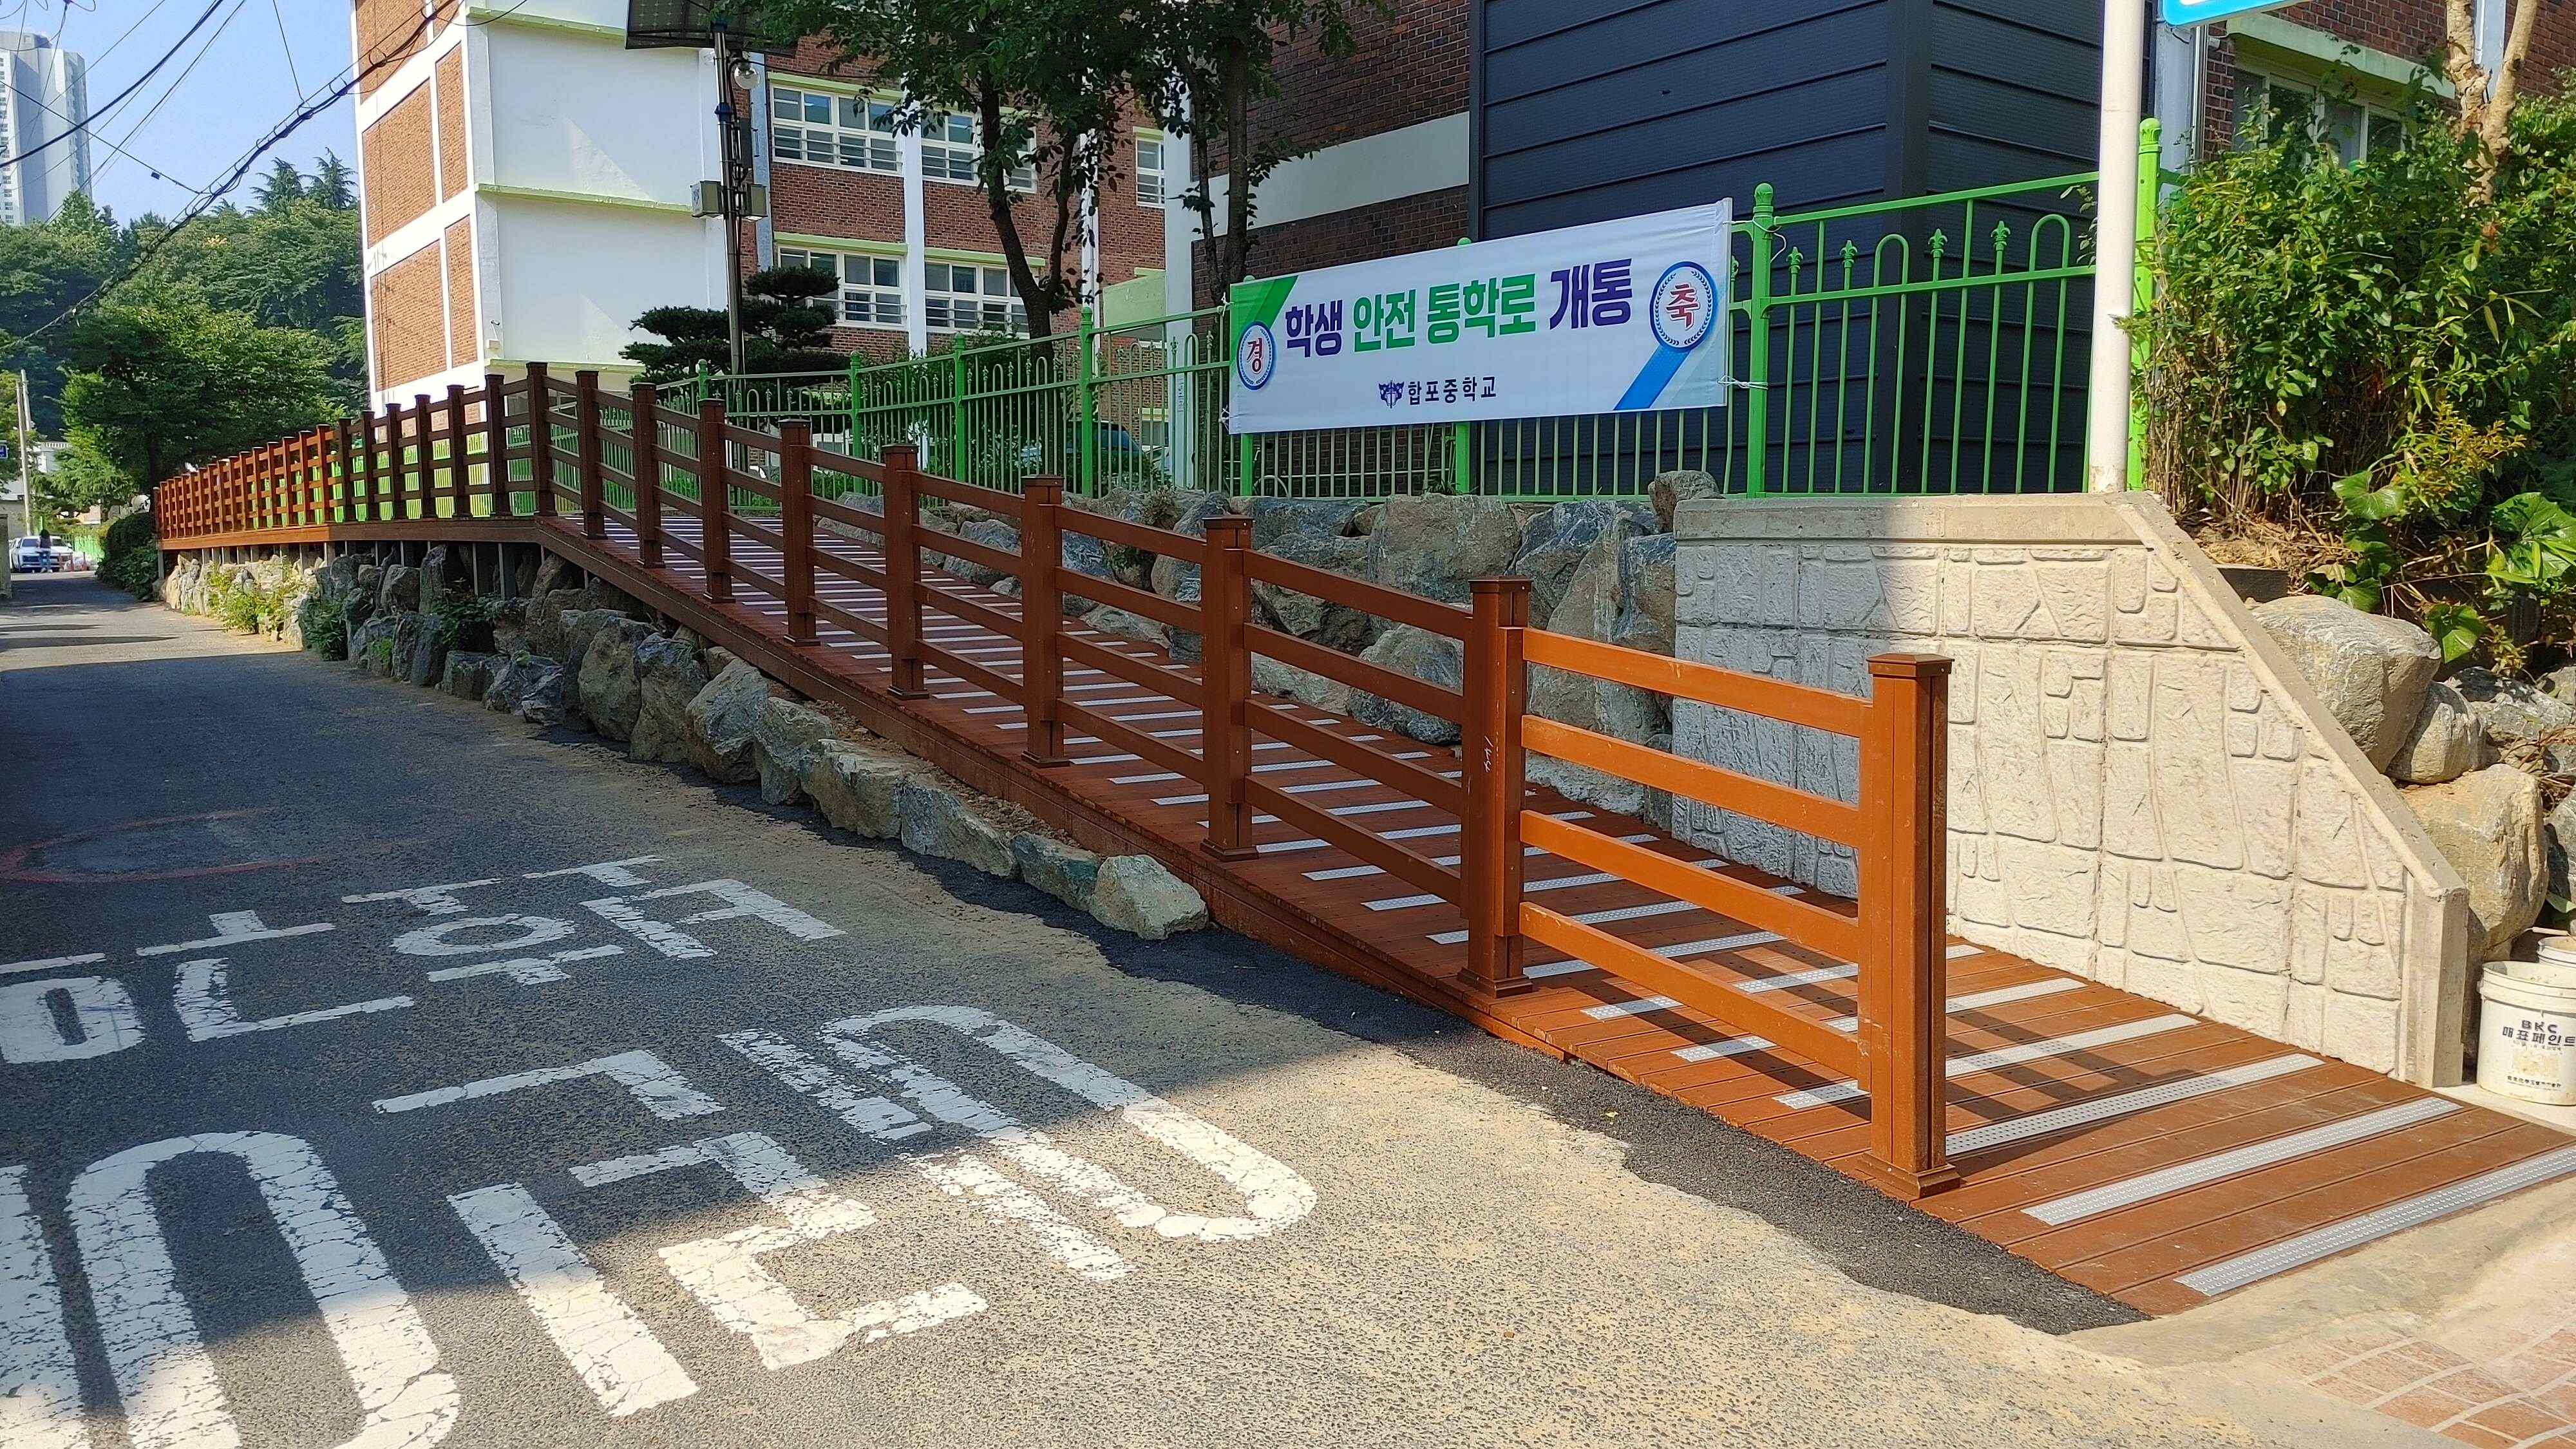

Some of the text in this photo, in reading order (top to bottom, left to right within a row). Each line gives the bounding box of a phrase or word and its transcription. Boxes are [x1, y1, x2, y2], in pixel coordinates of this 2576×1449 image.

[1285, 258, 1633, 358] 학생 안전 통학로 개통
[1665, 283, 1700, 328] 축
[1246, 337, 1263, 373] 경
[1408, 376, 1497, 406] 합포중학교
[2521, 1019, 2558, 1034] BKC
